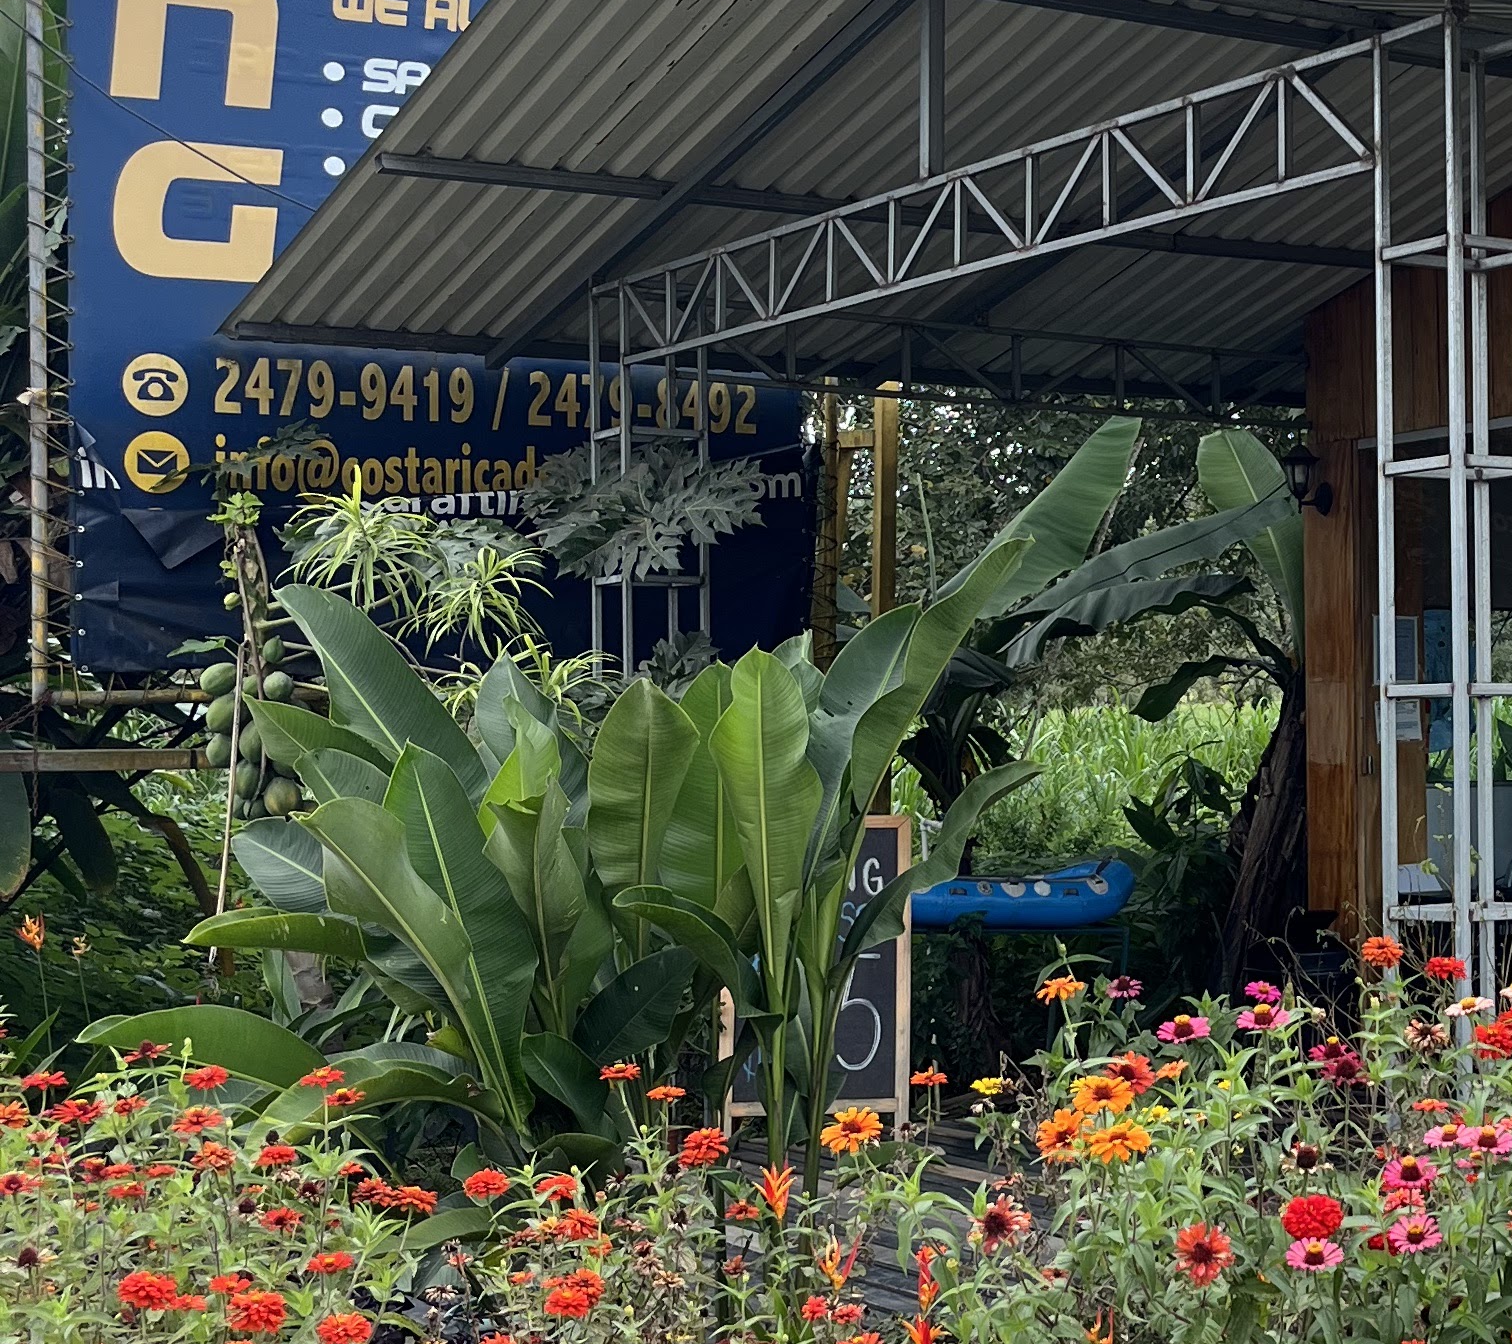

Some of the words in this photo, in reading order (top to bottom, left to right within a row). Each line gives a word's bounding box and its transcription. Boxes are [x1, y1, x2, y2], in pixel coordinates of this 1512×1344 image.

[213, 357, 475, 424] 2479-9419
[490, 367, 510, 432] /
[527, 369, 758, 435] 2479-8492
